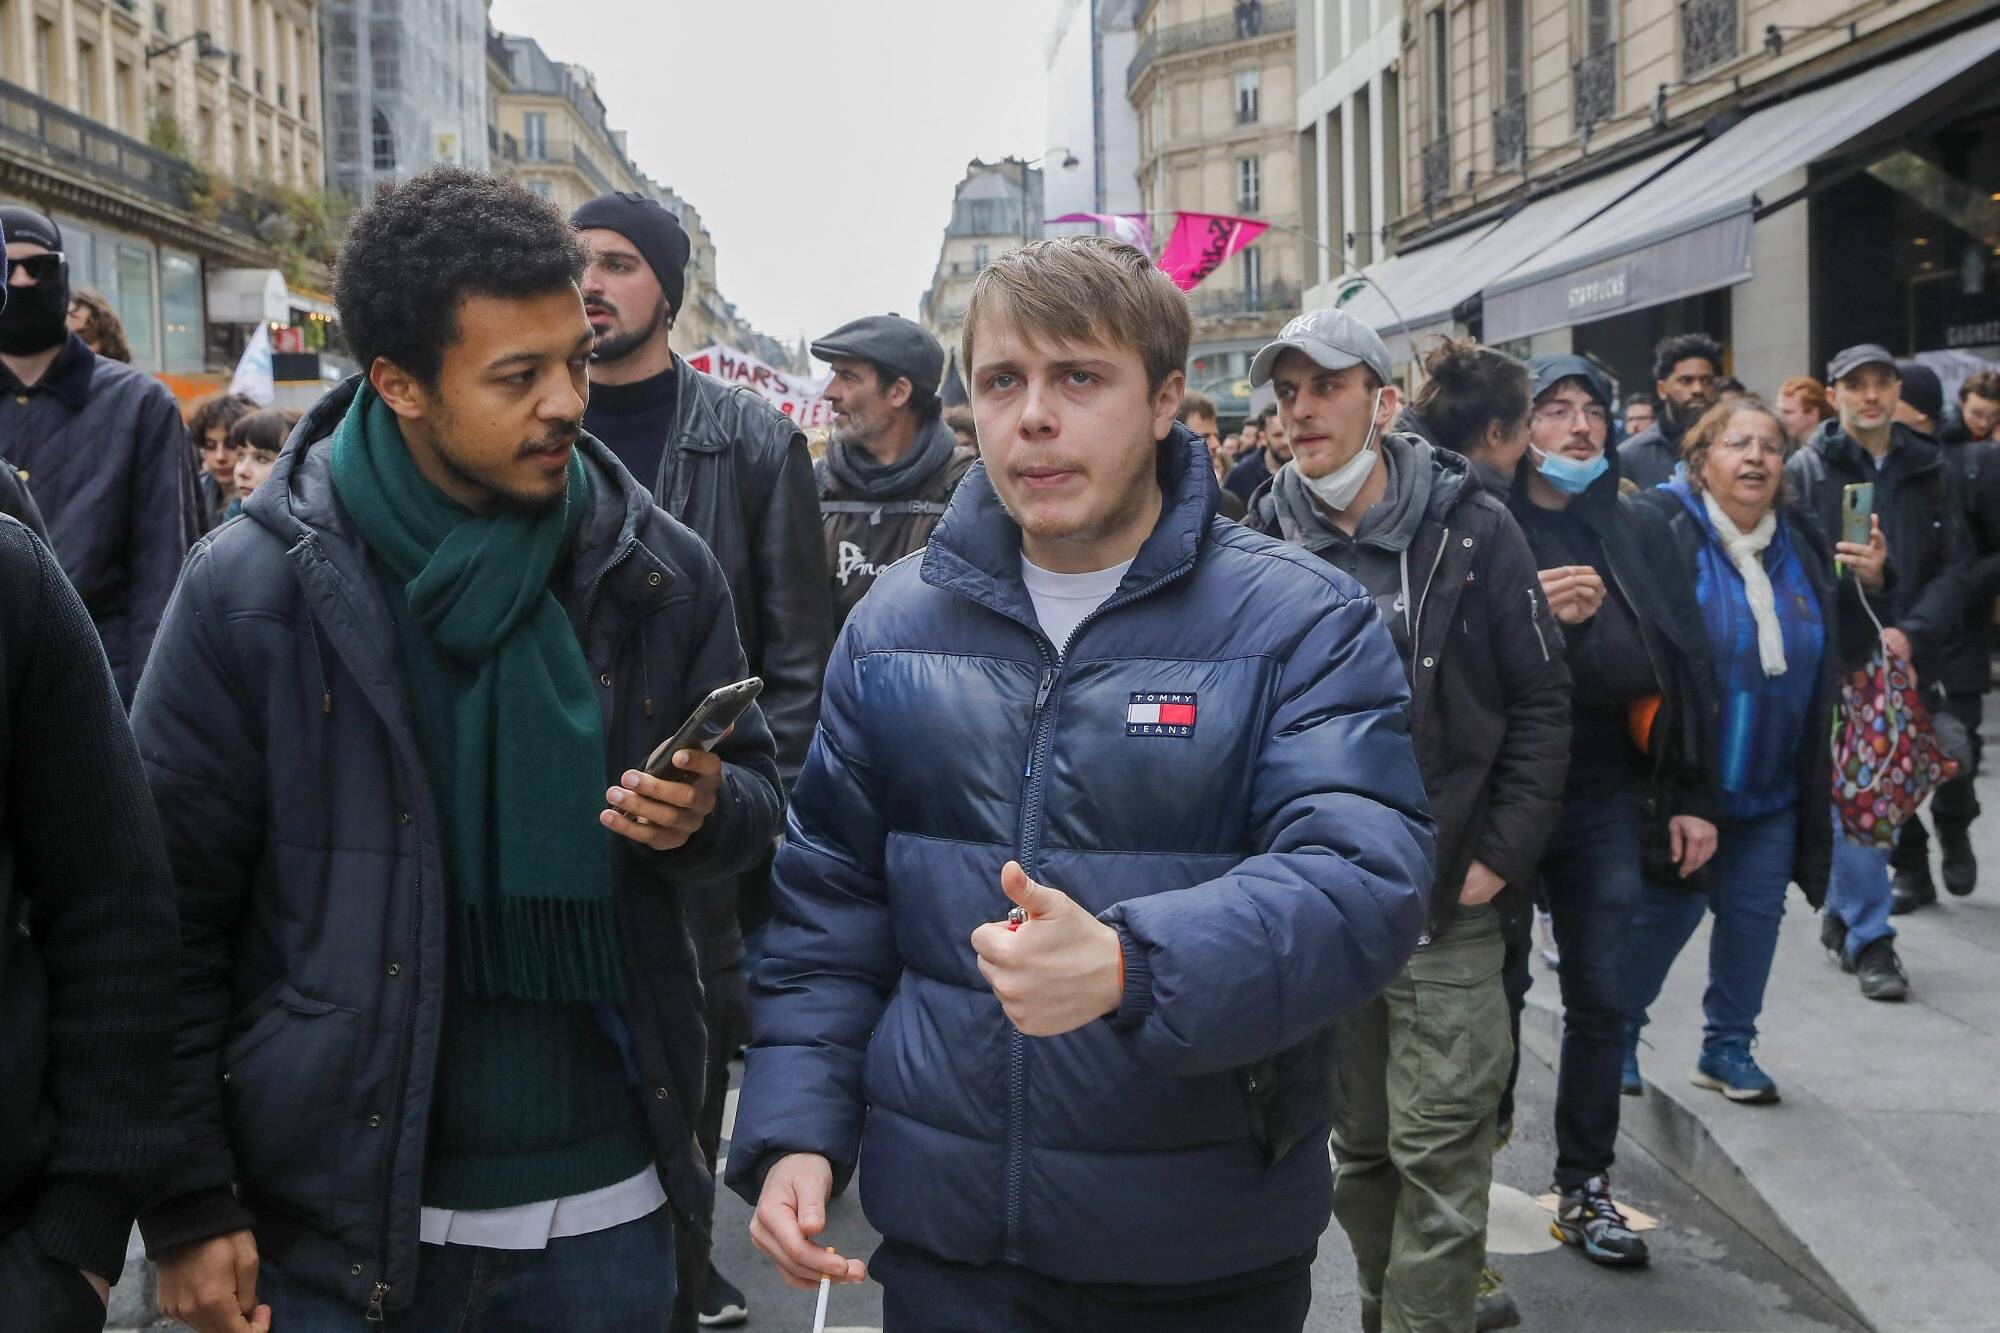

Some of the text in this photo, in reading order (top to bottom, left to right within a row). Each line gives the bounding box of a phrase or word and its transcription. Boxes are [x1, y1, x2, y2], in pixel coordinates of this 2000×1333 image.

[719, 353, 788, 394] MARS
[1135, 694, 1192, 703] TOMMY
[1130, 725, 1188, 735] JEANS
